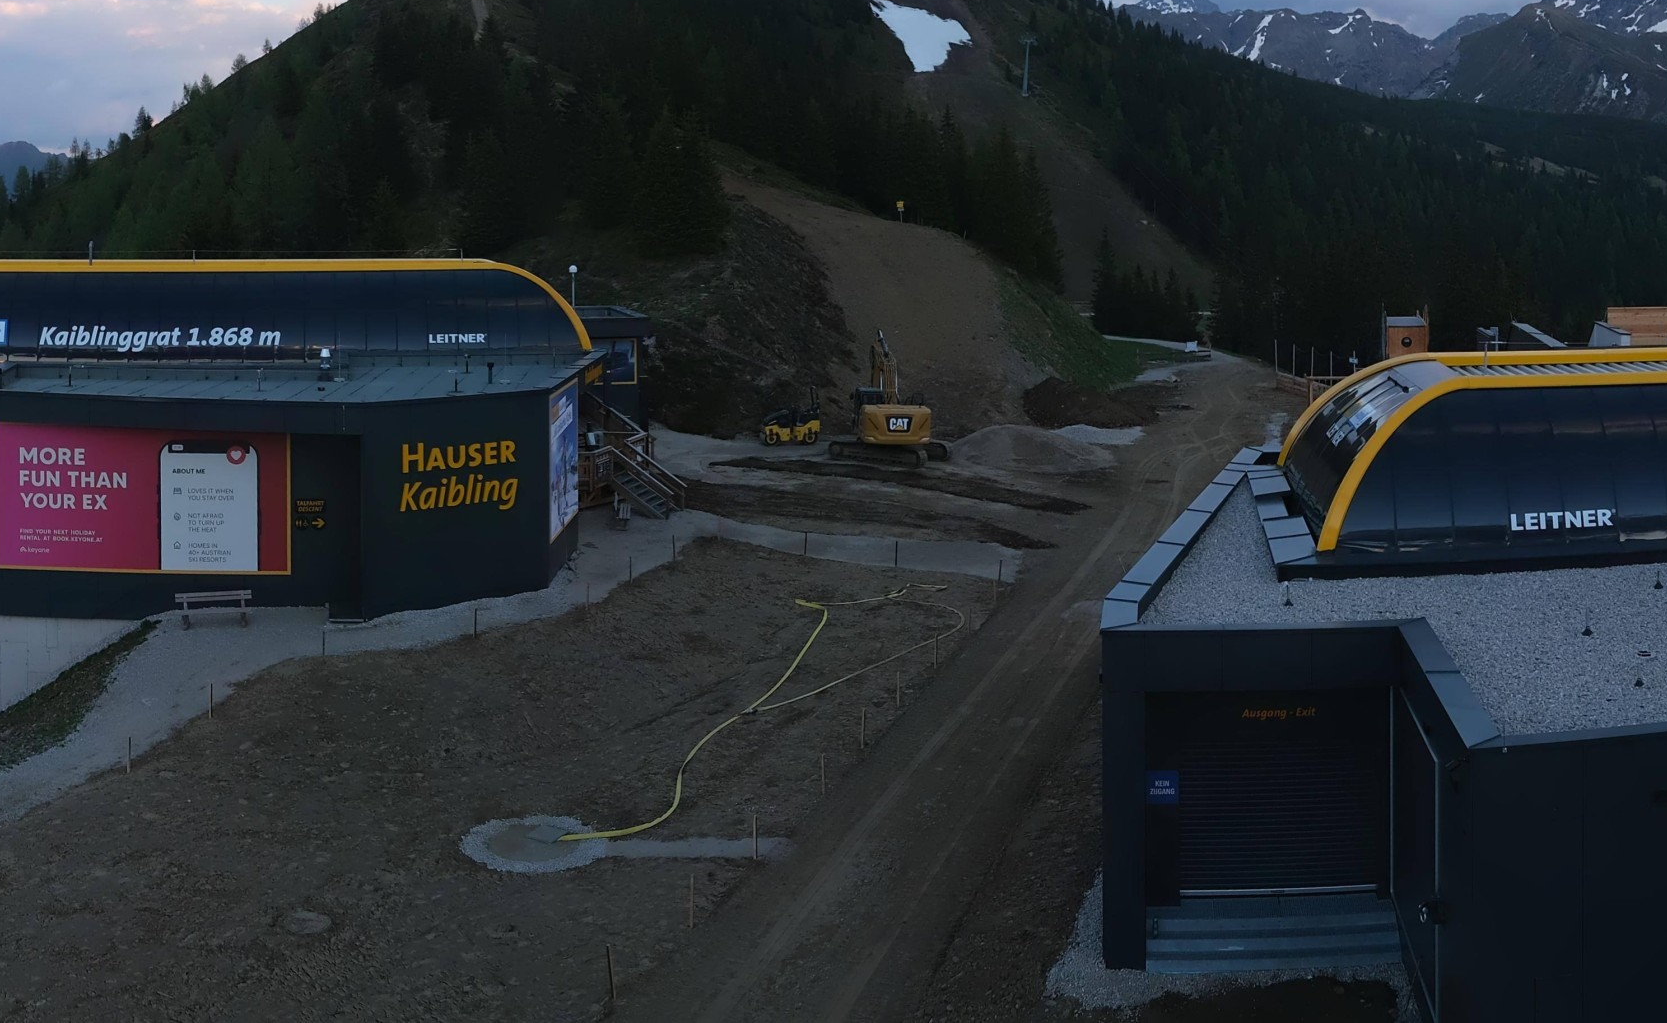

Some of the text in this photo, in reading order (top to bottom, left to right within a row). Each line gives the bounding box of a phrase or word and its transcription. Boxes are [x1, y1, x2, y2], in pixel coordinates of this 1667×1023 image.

[39, 325, 281, 352] Kaiblinggrat 1.868 m
[428, 333, 486, 344] LEITNER
[889, 418, 909, 430] CAT
[19, 447, 85, 465] MORE
[402, 440, 516, 473] HAUSER
[19, 470, 127, 488] FUN THAN
[20, 493, 107, 510] YOUR EX
[400, 474, 518, 512] Kaibling
[1510, 508, 1614, 531] LEITNER
[1242, 708, 1287, 720] Ausgang
[1295, 706, 1316, 716] Exit
